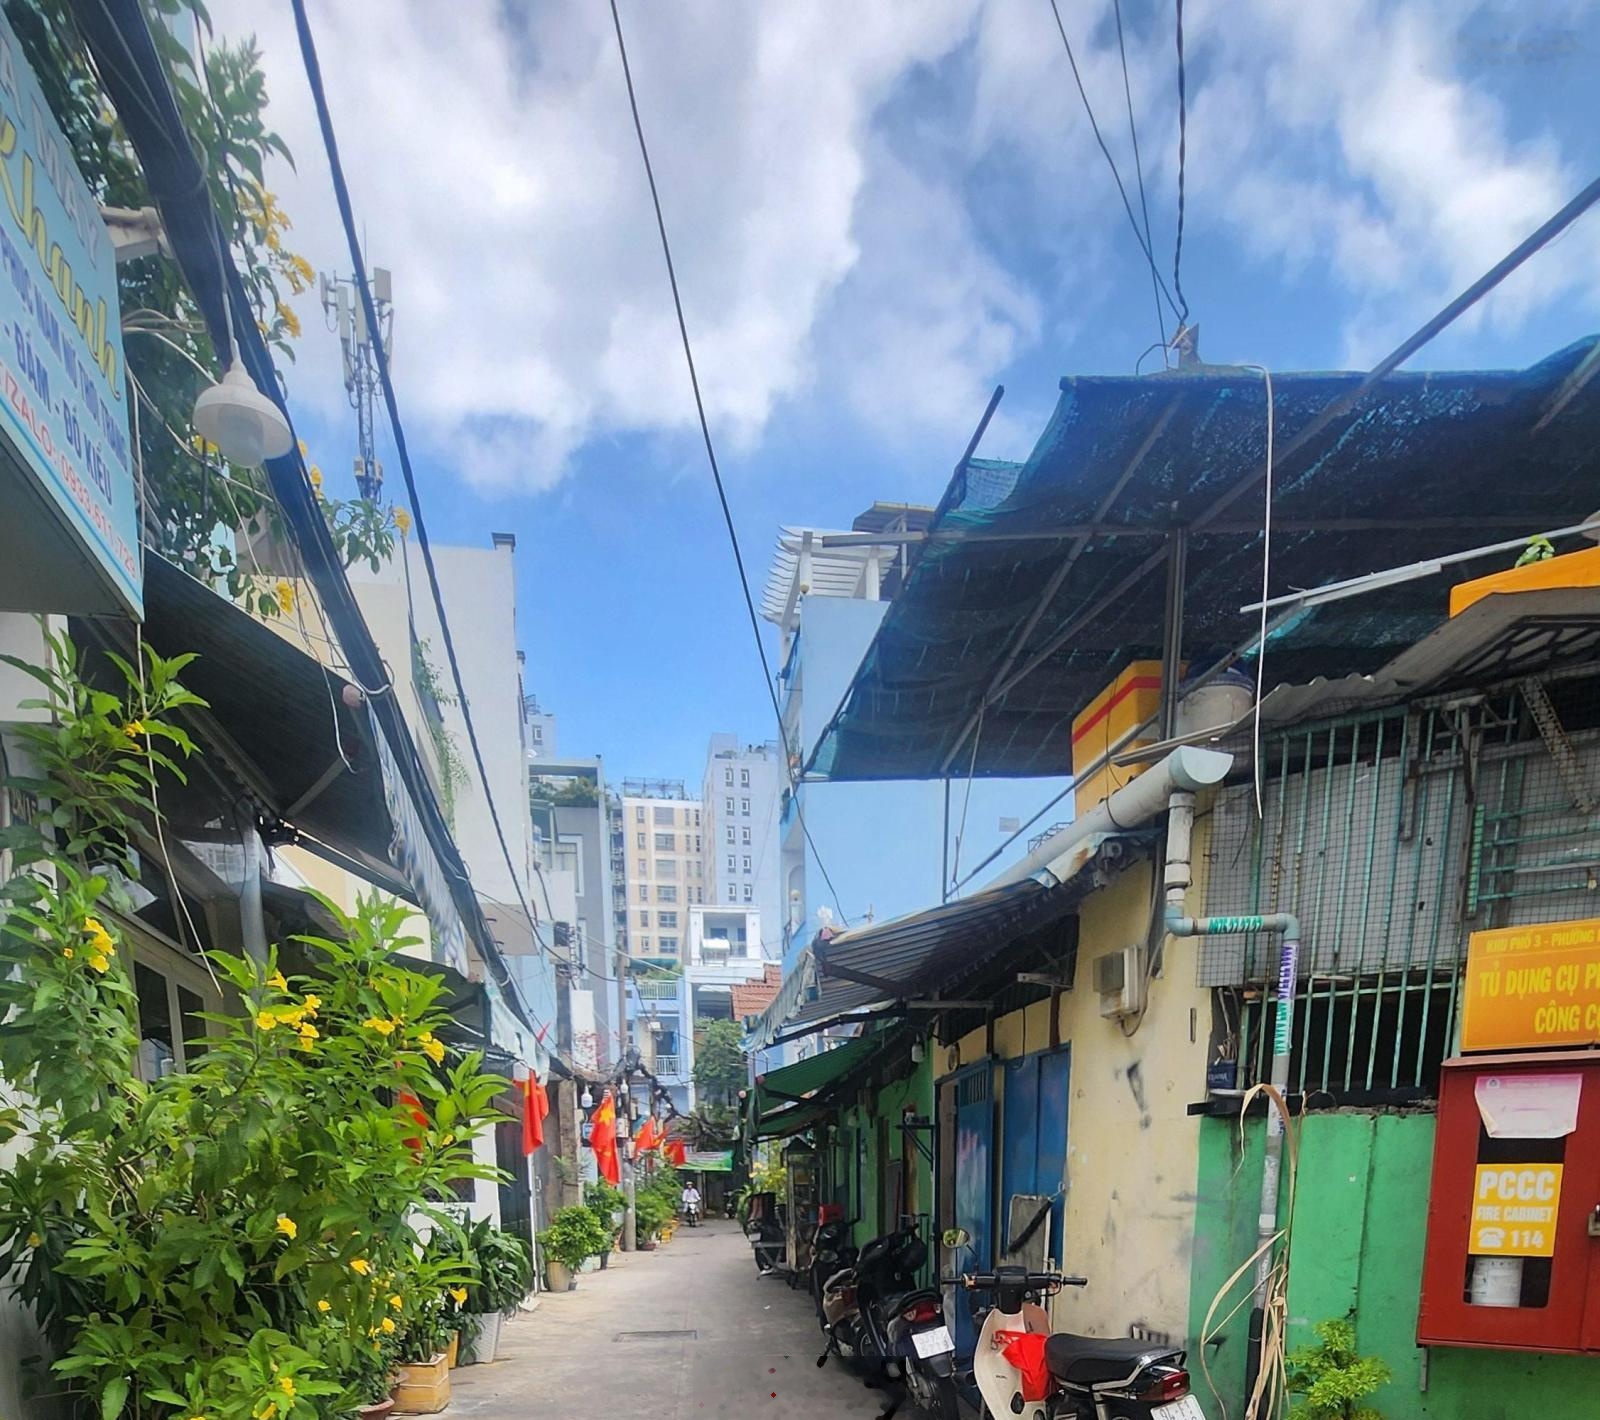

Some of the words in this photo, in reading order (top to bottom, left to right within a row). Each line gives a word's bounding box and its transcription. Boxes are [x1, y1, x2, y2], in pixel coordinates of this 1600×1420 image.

[1479, 961, 1501, 998] TỦ
[1504, 967, 1552, 1000] DỤNG
[1556, 963, 1580, 997] CỤ
[1534, 1000, 1581, 1034] CÔNG
[1478, 1169, 1556, 1201] PCCC
[1476, 1205, 1502, 1221] FIRE
[1510, 1230, 1545, 1249] 114
